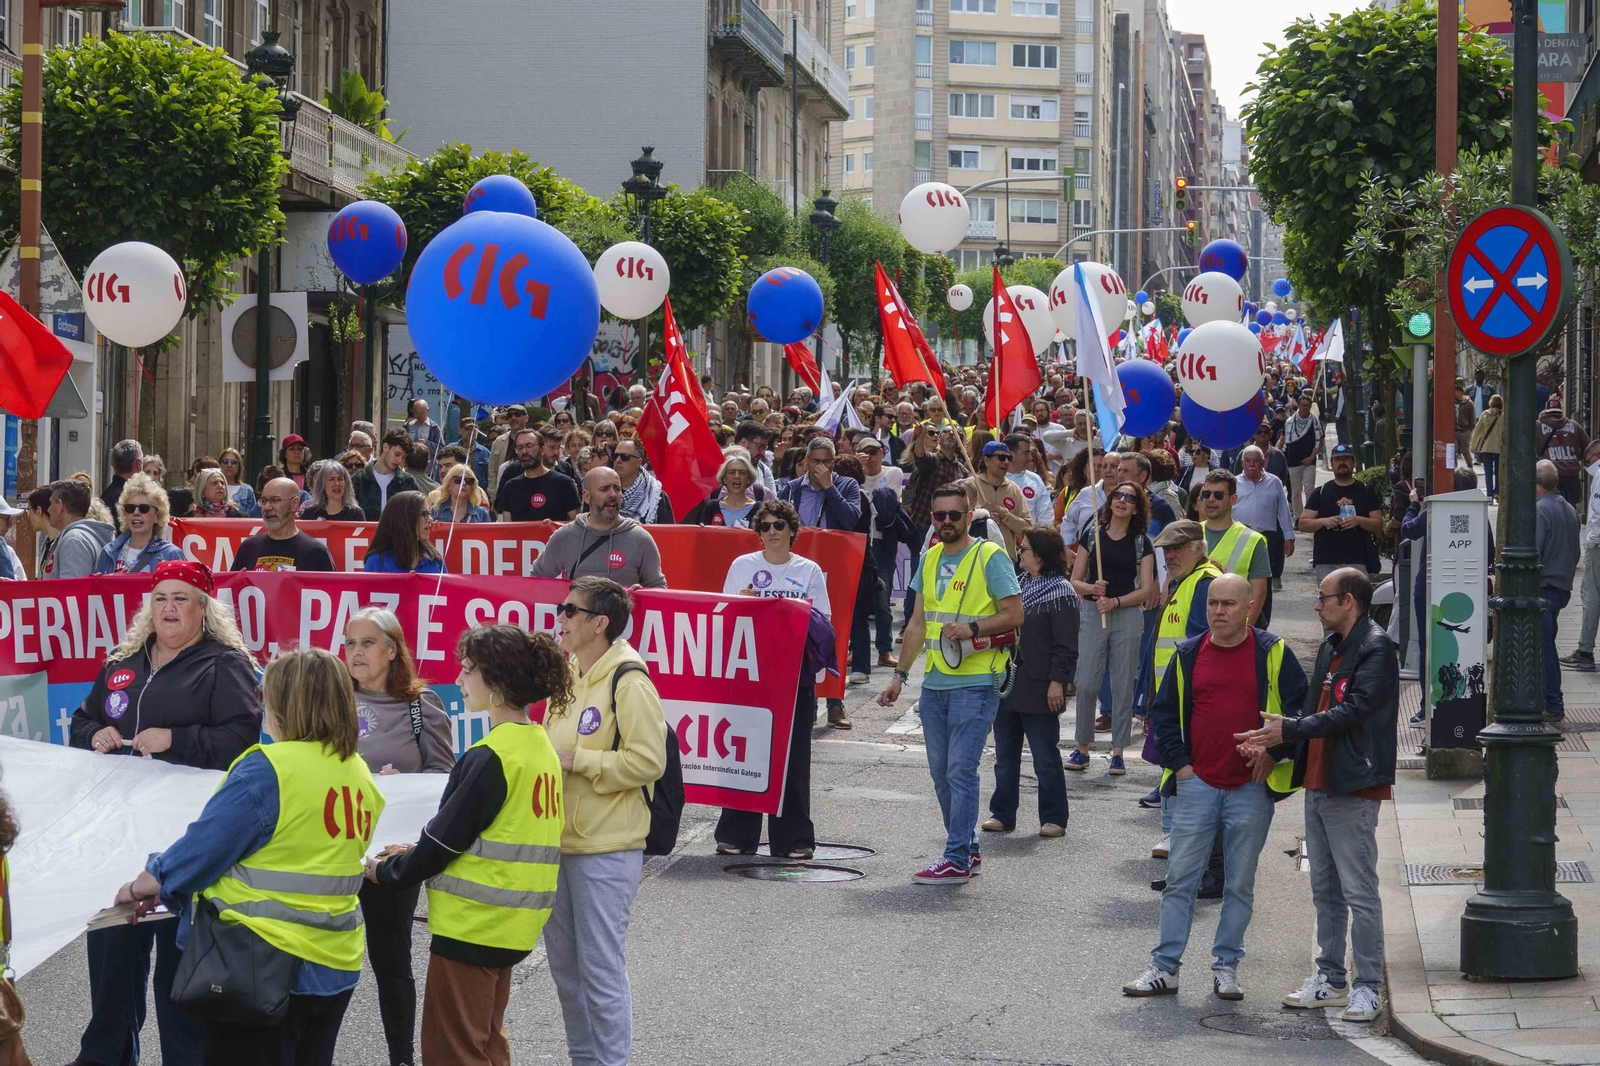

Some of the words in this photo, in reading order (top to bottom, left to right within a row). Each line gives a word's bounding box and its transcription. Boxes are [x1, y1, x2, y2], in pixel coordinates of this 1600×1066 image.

[1544, 38, 1581, 48] DENTAL
[1538, 52, 1572, 67] ARA
[926, 189, 961, 207] CIG
[330, 214, 369, 242] CIG
[616, 256, 654, 281] CIG
[87, 272, 130, 303] CIG
[443, 241, 551, 321] CIG
[1184, 284, 1209, 305] CIG
[57, 318, 79, 336] Exchange
[1179, 353, 1217, 381] CIG
[1449, 539, 1472, 549] APP
[758, 589, 808, 600] LESTINA
[416, 595, 447, 661] E
[113, 674, 130, 684] CIG
[675, 714, 747, 763] CIG
[681, 763, 702, 771] ración
[703, 764, 740, 775] Intersindical
[741, 768, 762, 778] Galega
[324, 786, 371, 842] CIG
